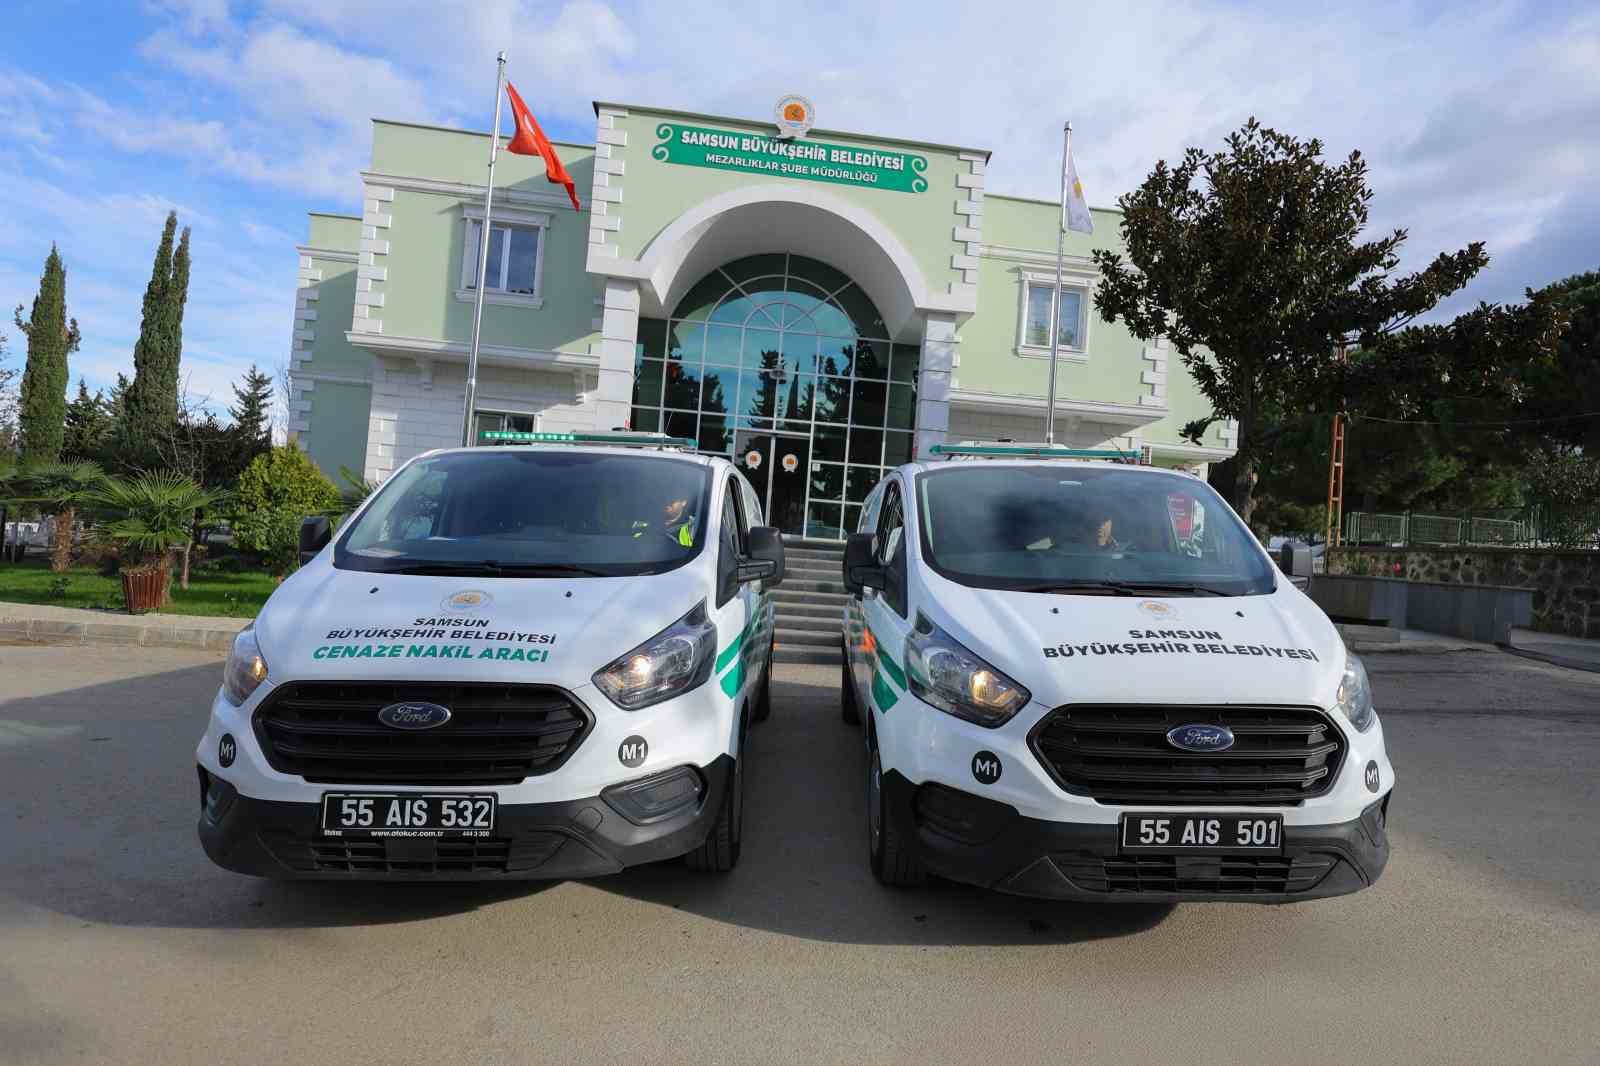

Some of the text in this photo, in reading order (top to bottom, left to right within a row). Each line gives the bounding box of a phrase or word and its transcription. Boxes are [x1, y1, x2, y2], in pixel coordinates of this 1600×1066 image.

[681, 131, 905, 171] SAMSUN BÜYÜKŞEHİR BELEDİYESİ
[705, 153, 879, 183] MEZARLIKLAR ŞUBE MÜDÜRLÜĞÜ
[413, 617, 490, 628] SAMSUN
[326, 626, 557, 645] BÜYÜKŞEHİR BELEDİYESİ
[1128, 629, 1223, 641] SAMSUN
[313, 644, 550, 663] CENAZE NAKİL ARACI
[1042, 641, 1320, 663] BÜYÜKŞEHİR BELEDİYESİ
[391, 703, 433, 723] Ford
[1184, 728, 1221, 746] Ford
[221, 741, 234, 761] M1
[622, 742, 645, 761] M1
[975, 758, 998, 777] M1
[1366, 768, 1379, 785] M1
[341, 799, 490, 828] 55 AIS 532
[1139, 819, 1277, 846] 55 AIS 501
